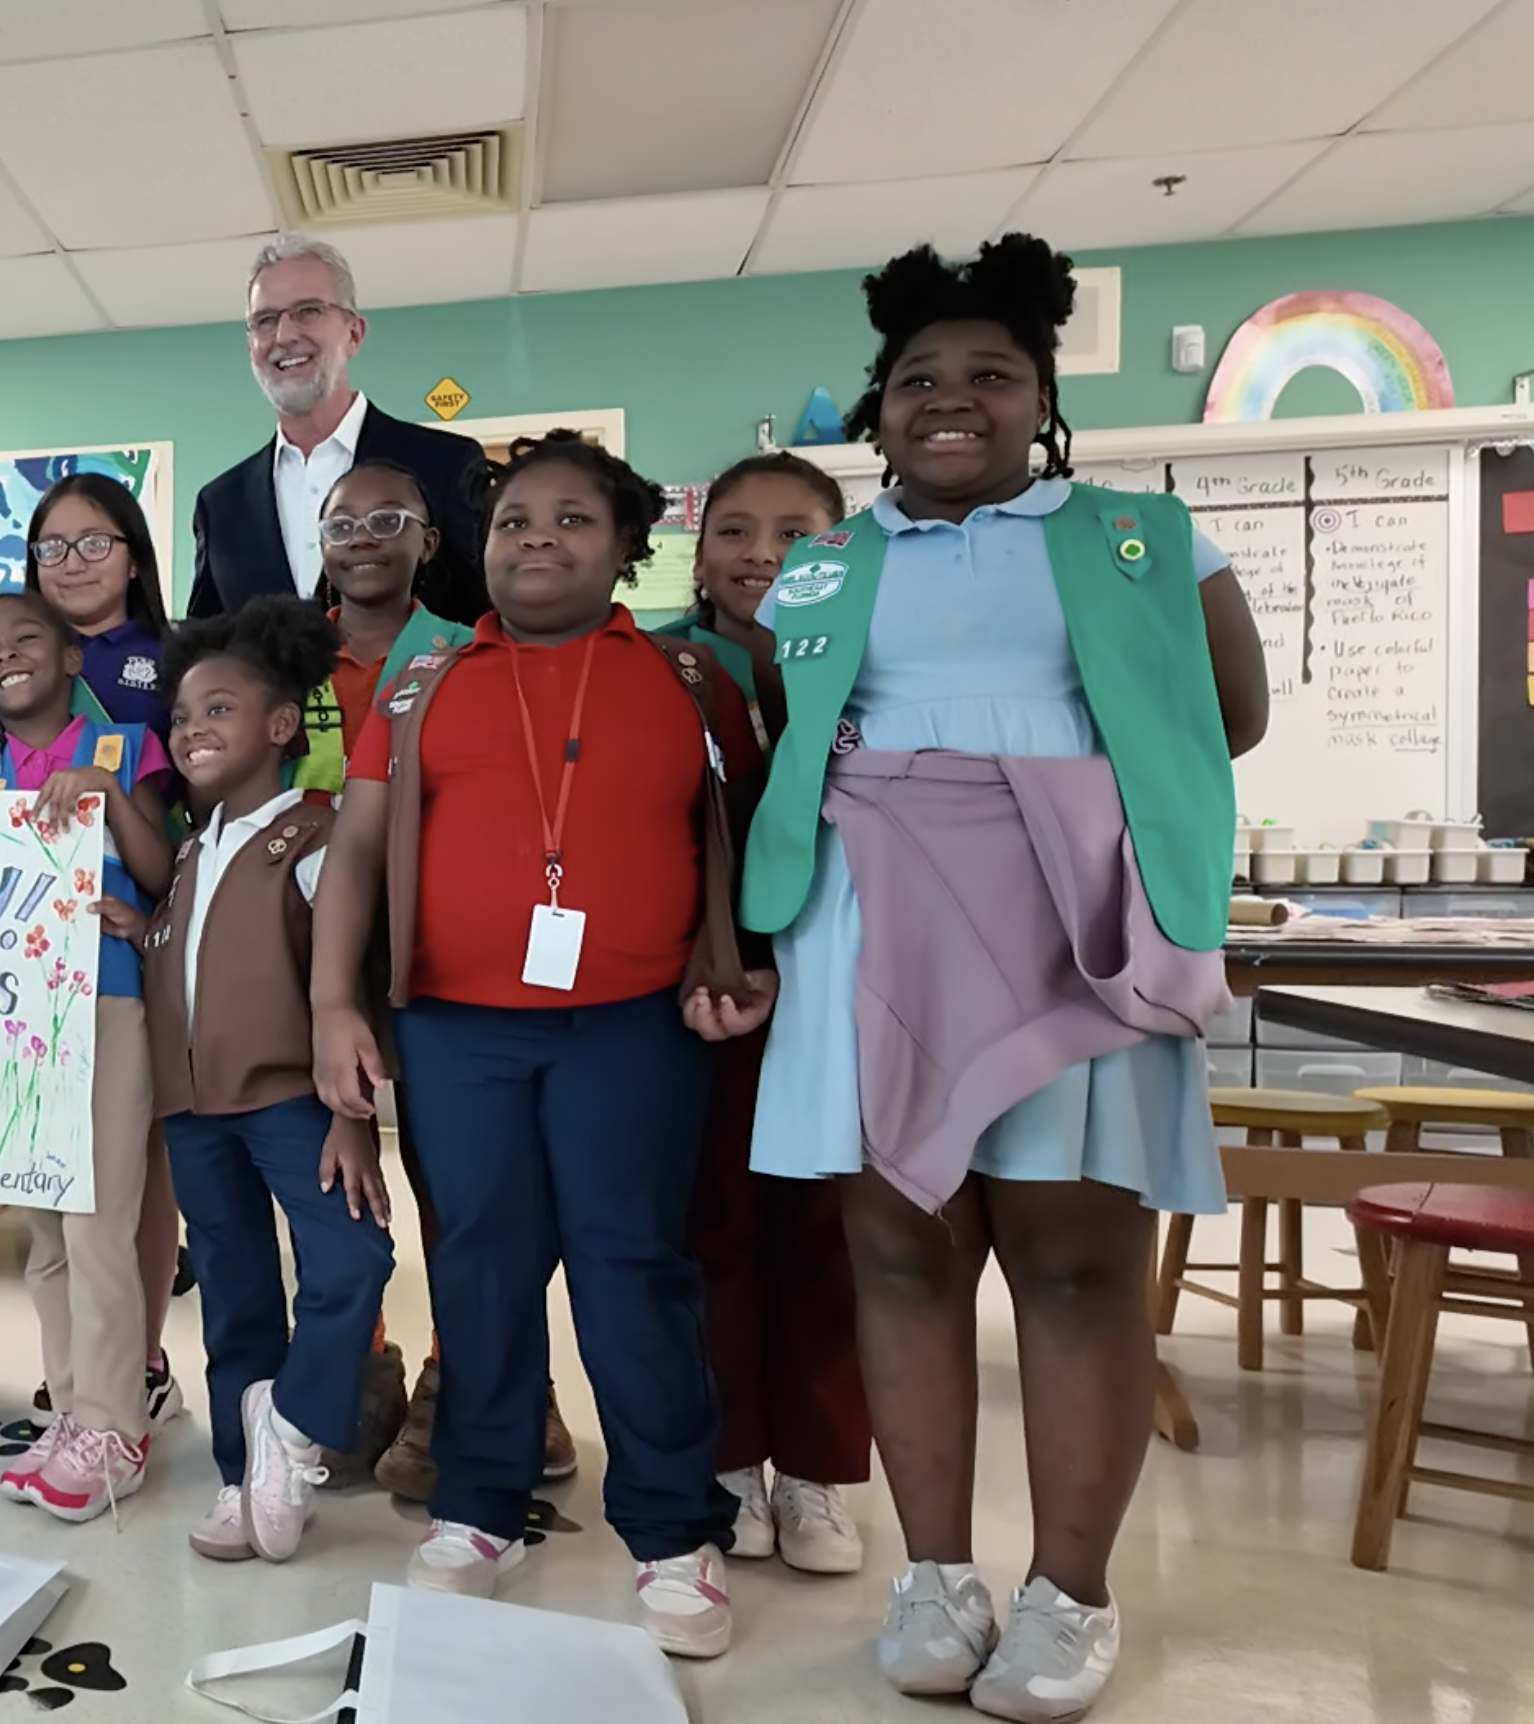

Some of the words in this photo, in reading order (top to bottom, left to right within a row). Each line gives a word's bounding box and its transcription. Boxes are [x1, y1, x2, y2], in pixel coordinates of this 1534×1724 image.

[1237, 476, 1297, 494] Grade
[1335, 463, 1368, 486] 5th
[1375, 467, 1435, 490] Grade
[1234, 519, 1264, 532] can
[1346, 509, 1359, 529] I
[1375, 514, 1407, 528] can
[1333, 639, 1366, 658] Use
[1373, 637, 1434, 656] colorful
[1329, 665, 1380, 682] paper
[1396, 660, 1415, 676] to
[1326, 729, 1378, 749] mask
